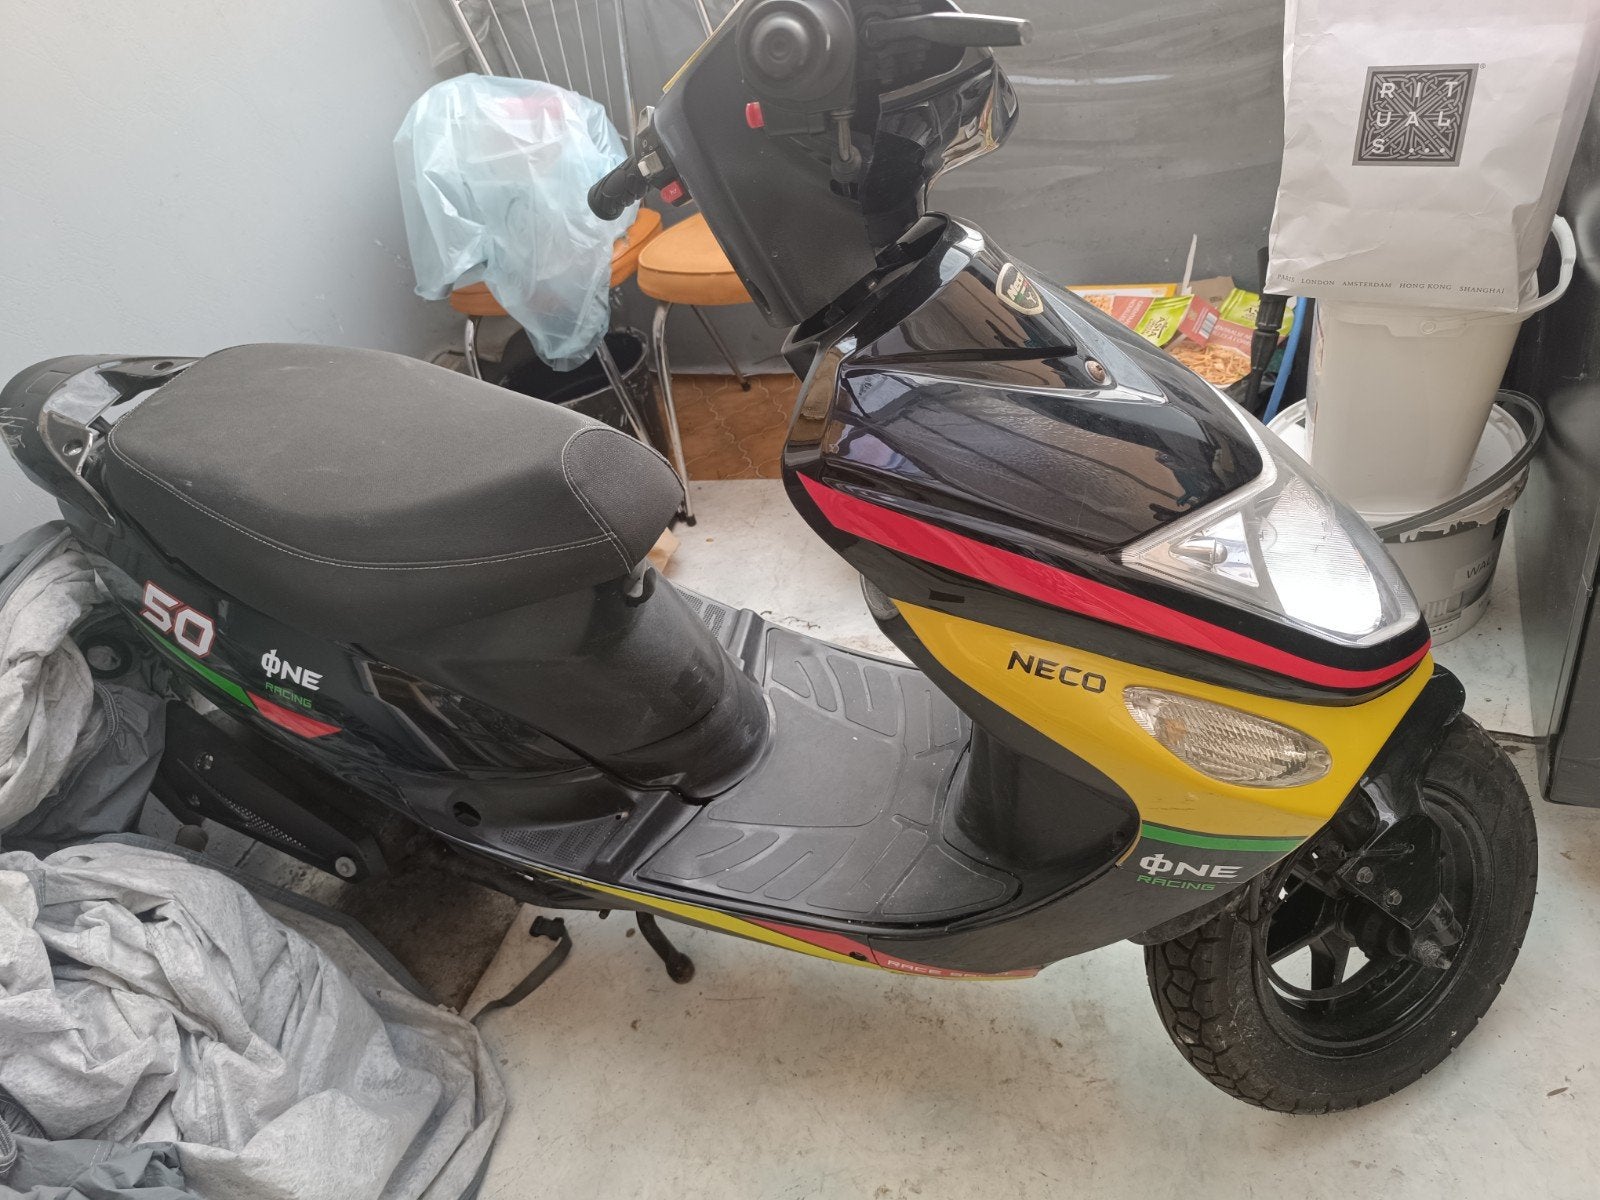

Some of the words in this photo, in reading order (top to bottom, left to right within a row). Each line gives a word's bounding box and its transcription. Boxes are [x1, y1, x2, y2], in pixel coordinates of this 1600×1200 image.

[1277, 273, 1296, 283] PARIS
[1300, 277, 1336, 286] LONDON
[1342, 280, 1393, 289] AMSTERDAM
[1399, 282, 1425, 290] HONG
[1427, 283, 1453, 291] KONG
[1459, 286, 1505, 295] SHANGHAI
[140, 580, 217, 659] 50
[1007, 650, 1107, 694] NECO
[265, 682, 313, 709] RACING
[1136, 874, 1216, 892] RACING
[887, 959, 942, 975] RACE
